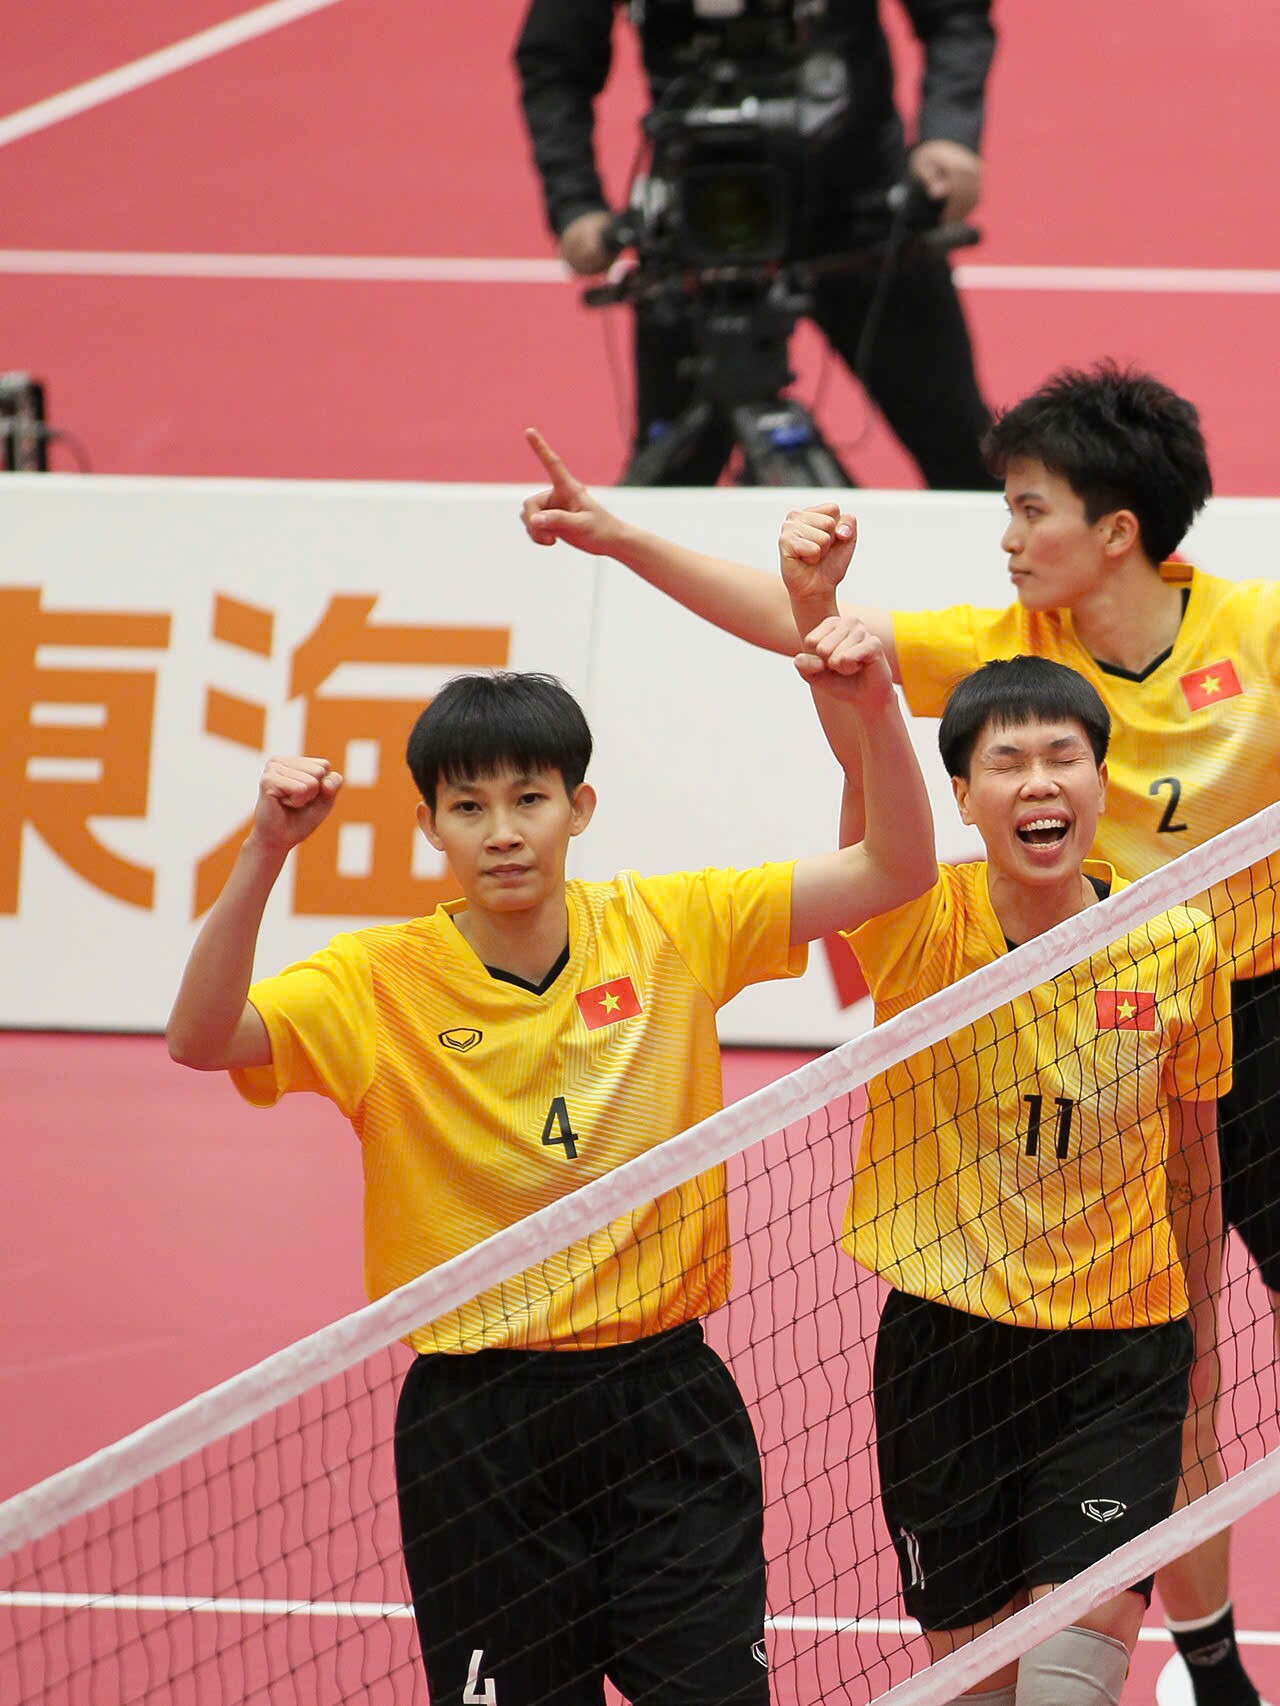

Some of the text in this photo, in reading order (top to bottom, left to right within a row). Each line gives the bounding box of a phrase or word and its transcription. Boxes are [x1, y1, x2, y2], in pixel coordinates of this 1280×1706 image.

[1149, 777, 1188, 833] 2
[541, 1096, 578, 1160] 4
[1023, 1094, 1074, 1159] 11
[462, 1649, 498, 1706] 4
